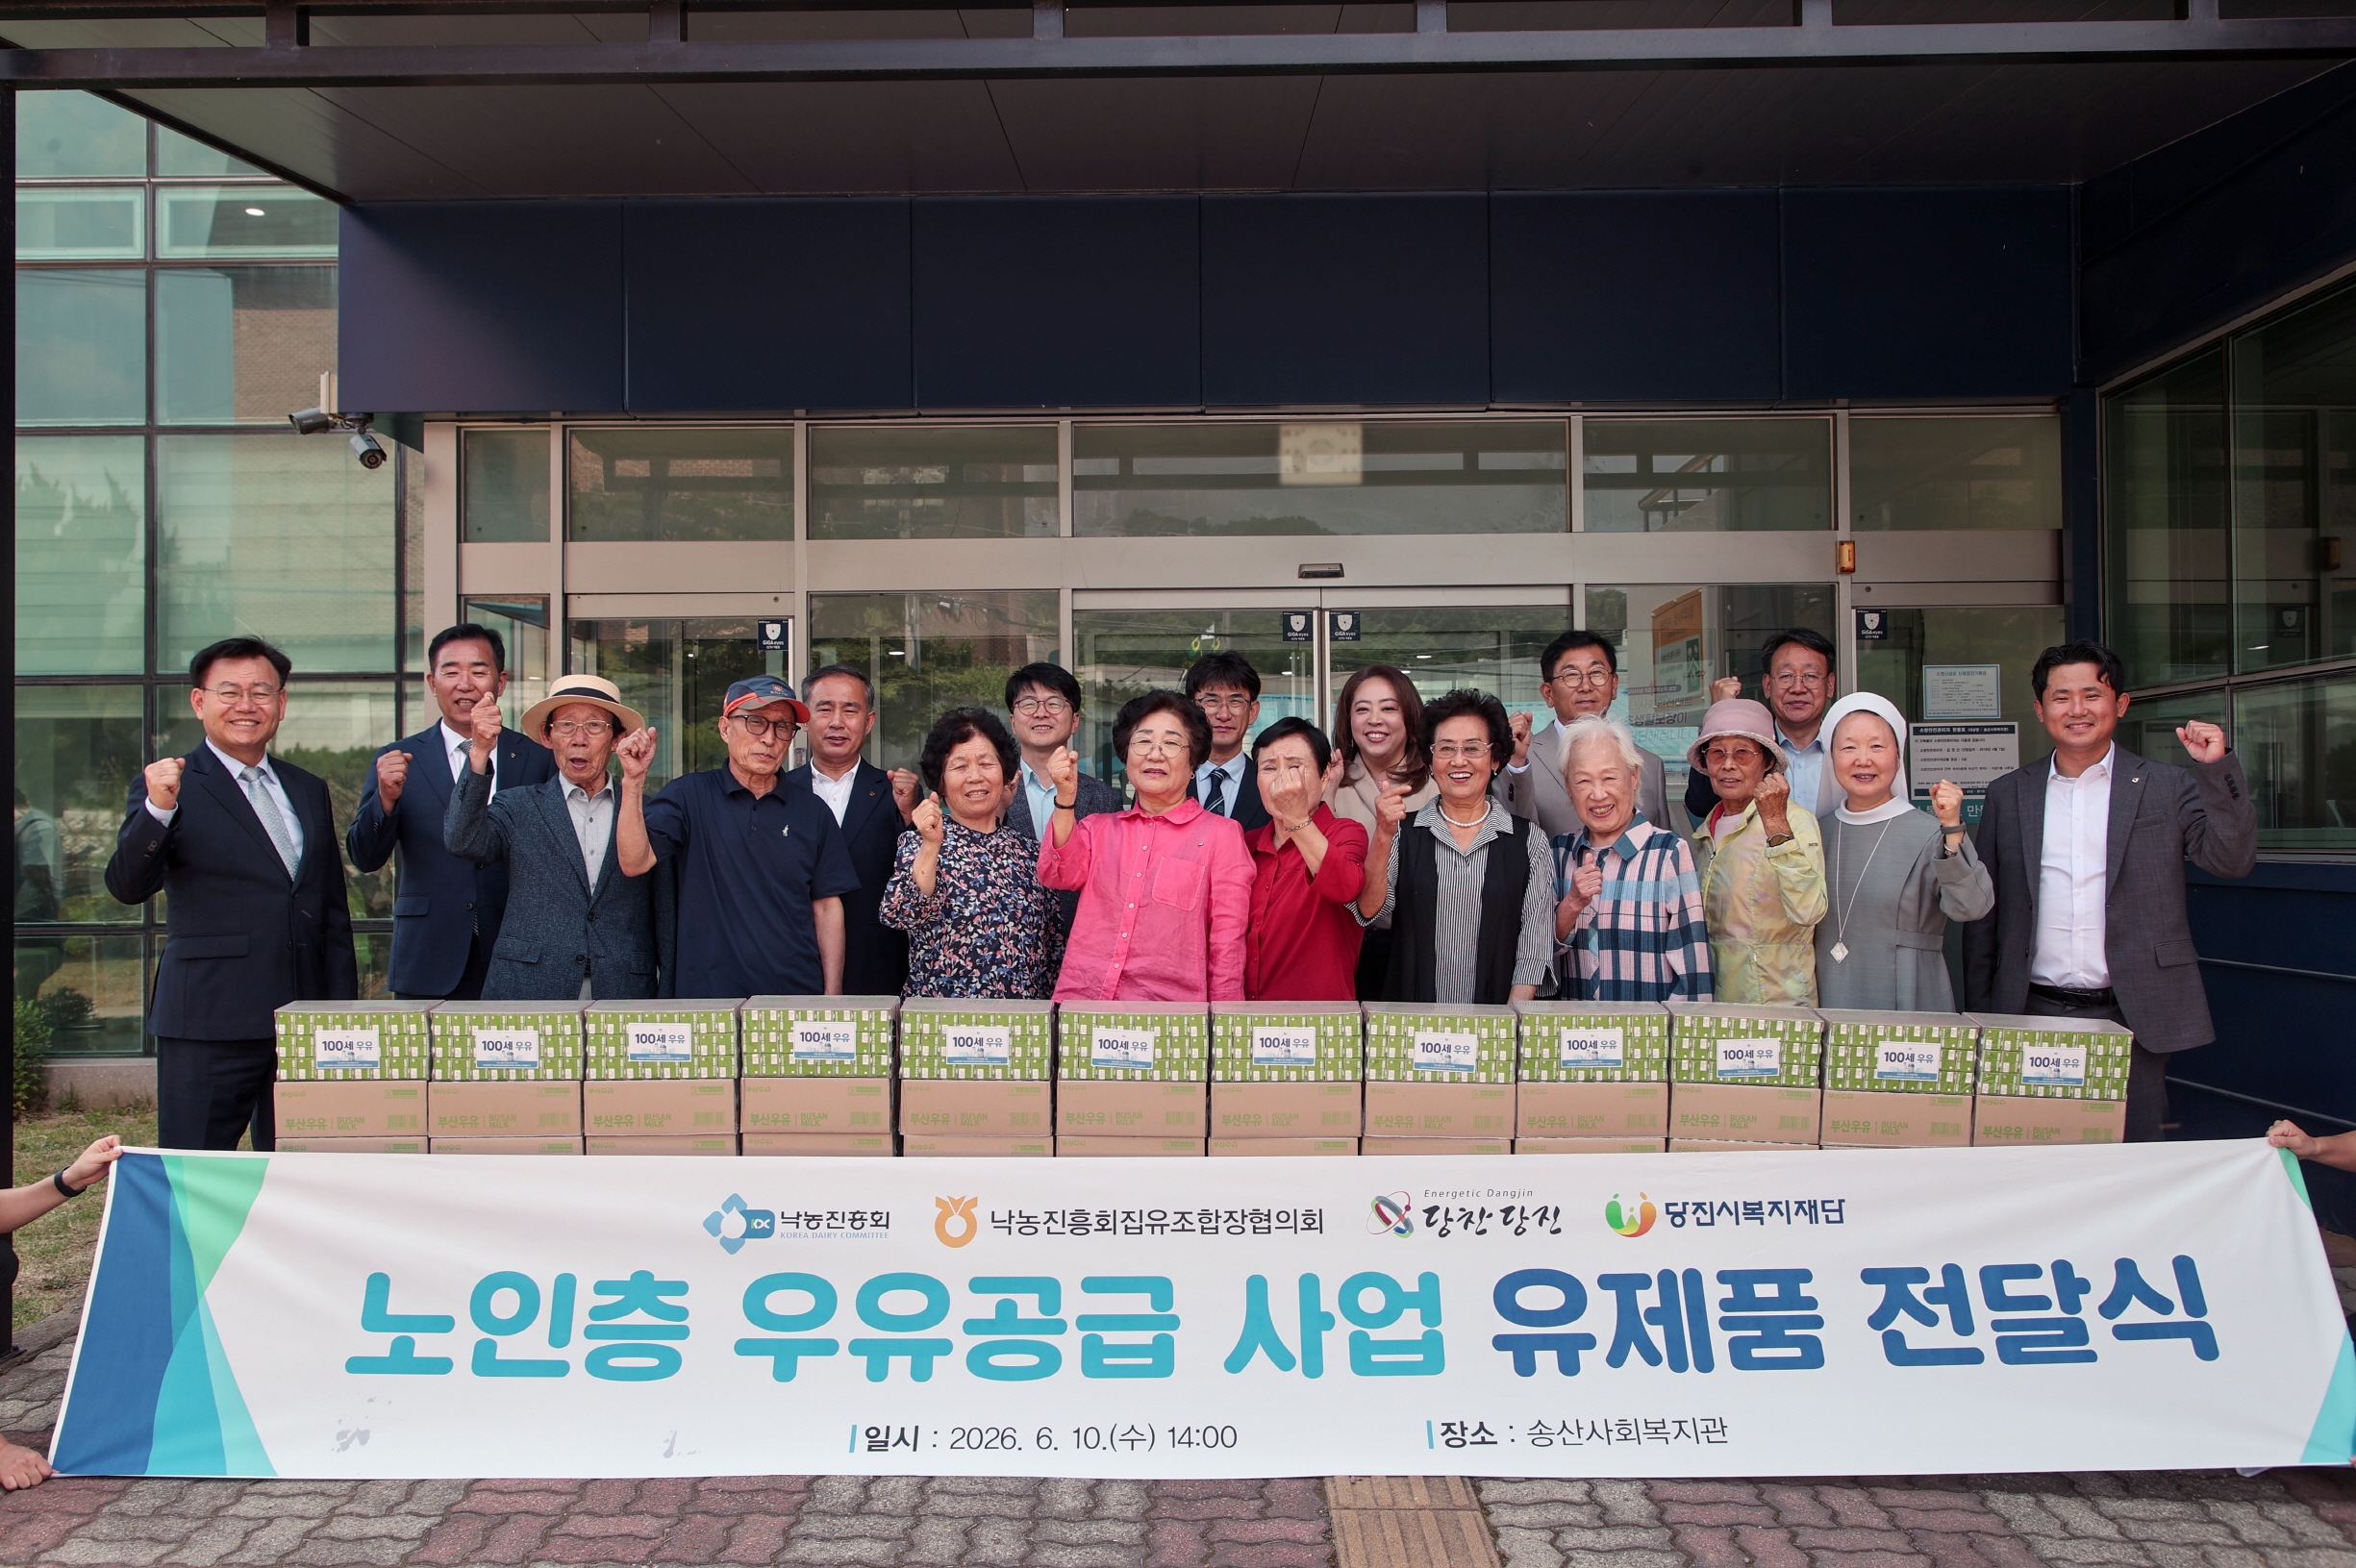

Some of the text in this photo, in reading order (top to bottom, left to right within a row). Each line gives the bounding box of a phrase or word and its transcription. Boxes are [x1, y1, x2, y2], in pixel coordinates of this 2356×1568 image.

[636, 1033, 685, 1044] 100세 우유
[800, 1033, 849, 1042] 100세 우유
[953, 1037, 1002, 1047] 100세 우유
[1260, 1037, 1309, 1048] 100세 우유
[322, 1041, 373, 1051] 100세 우유
[482, 1041, 532, 1051] 100세 우유
[1098, 1039, 1147, 1051] 100세 우유
[1421, 1043, 1469, 1055] 100세 우유
[1567, 1040, 1617, 1050] 100세 우유
[1723, 1050, 1773, 1059] 100세 우유
[1885, 1052, 1934, 1063] 100세 우유
[2030, 1057, 2079, 1068] 100세 우유
[439, 1116, 479, 1128] 부산우유
[593, 1115, 634, 1128] 부산우유
[750, 1113, 790, 1126] 부산우유
[912, 1113, 950, 1125] 부산우유
[1066, 1112, 1105, 1124] 부산우유
[1222, 1114, 1262, 1126] 부산우유
[1375, 1116, 1414, 1128] 부산우유
[1528, 1116, 1566, 1128] 부산우유
[1681, 1114, 1719, 1126] 부산우유
[286, 1118, 326, 1131] 부산우유
[1831, 1121, 1871, 1132] 부산우유
[1983, 1127, 2022, 1138] 부산우유
[1424, 1188, 1533, 1200] Energetic Dangjin
[1665, 1198, 1845, 1228] 당진시복지재단
[781, 1210, 890, 1231] 낙농진흥회
[990, 1208, 1323, 1236] 낙농진흥회집유조합장협의회
[344, 1254, 2220, 1383] 노인층 우유공급 사업 유제품 전달식
[865, 1426, 919, 1453] 일시
[949, 1427, 1022, 1451] 2026.
[1036, 1427, 1059, 1451] 6.
[1072, 1423, 1156, 1453] 10.(수)
[1167, 1425, 1238, 1449] 14:00
[1440, 1420, 1498, 1449] 장소
[1526, 1417, 1728, 1448] 송산사회복지관
